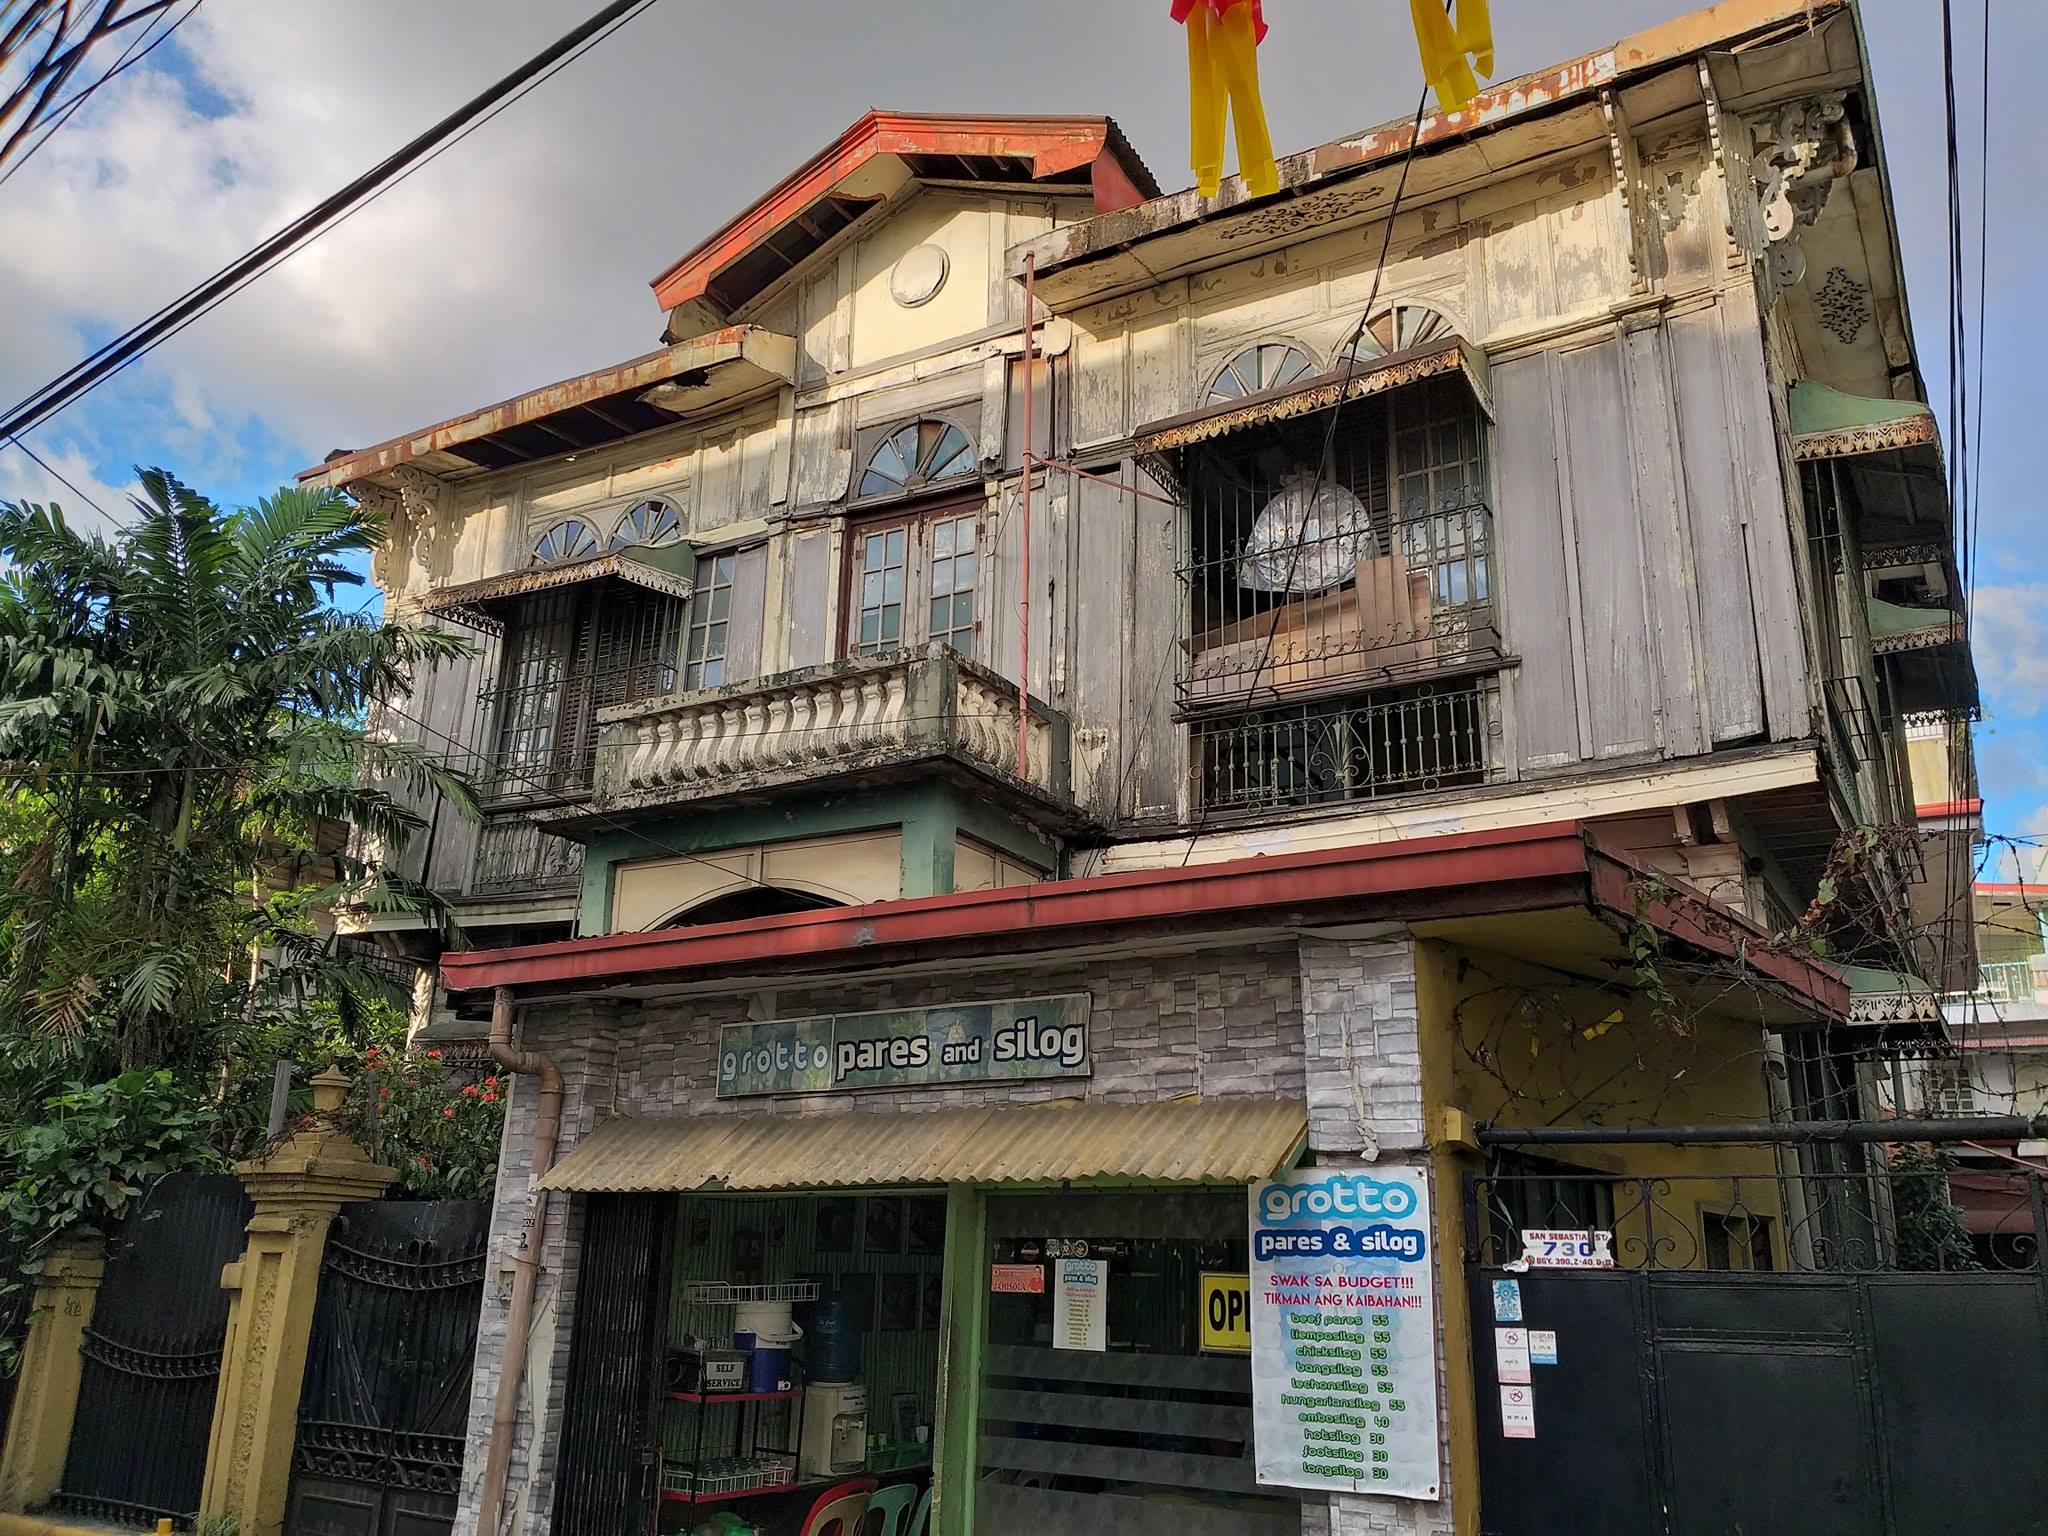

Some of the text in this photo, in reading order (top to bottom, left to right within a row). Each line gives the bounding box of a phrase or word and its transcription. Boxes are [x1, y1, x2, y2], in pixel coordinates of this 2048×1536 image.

[722, 1019, 1085, 1081] grotto pares and silog
[1265, 1181, 1410, 1221] grotto
[1261, 1230, 1418, 1256] pares & silog
[1549, 1233, 1592, 1241] SEBASTIA
[1543, 1241, 1594, 1257] 730
[1270, 1275, 1414, 1289] SWAK SA BUDGET!!!
[1264, 1292, 1422, 1308] TIKMAN ANG KAIBAHAN!!!
[1290, 1312, 1390, 1327] beef pares 55
[1290, 1328, 1391, 1344] liemposilog 55
[1296, 1345, 1387, 1360] chicksilog 55
[715, 1363, 735, 1373] SELF
[1296, 1361, 1388, 1377] bangsilog 55
[706, 1378, 741, 1388] SERVICE
[1291, 1377, 1394, 1394] lechonsilog 55
[1280, 1394, 1405, 1411] hungariansilog 55
[1298, 1412, 1390, 1428] embosilog 40
[1304, 1428, 1385, 1445] hotsilog 30
[1302, 1445, 1388, 1462] footsilog 30
[1302, 1462, 1388, 1479] longsilog 30
